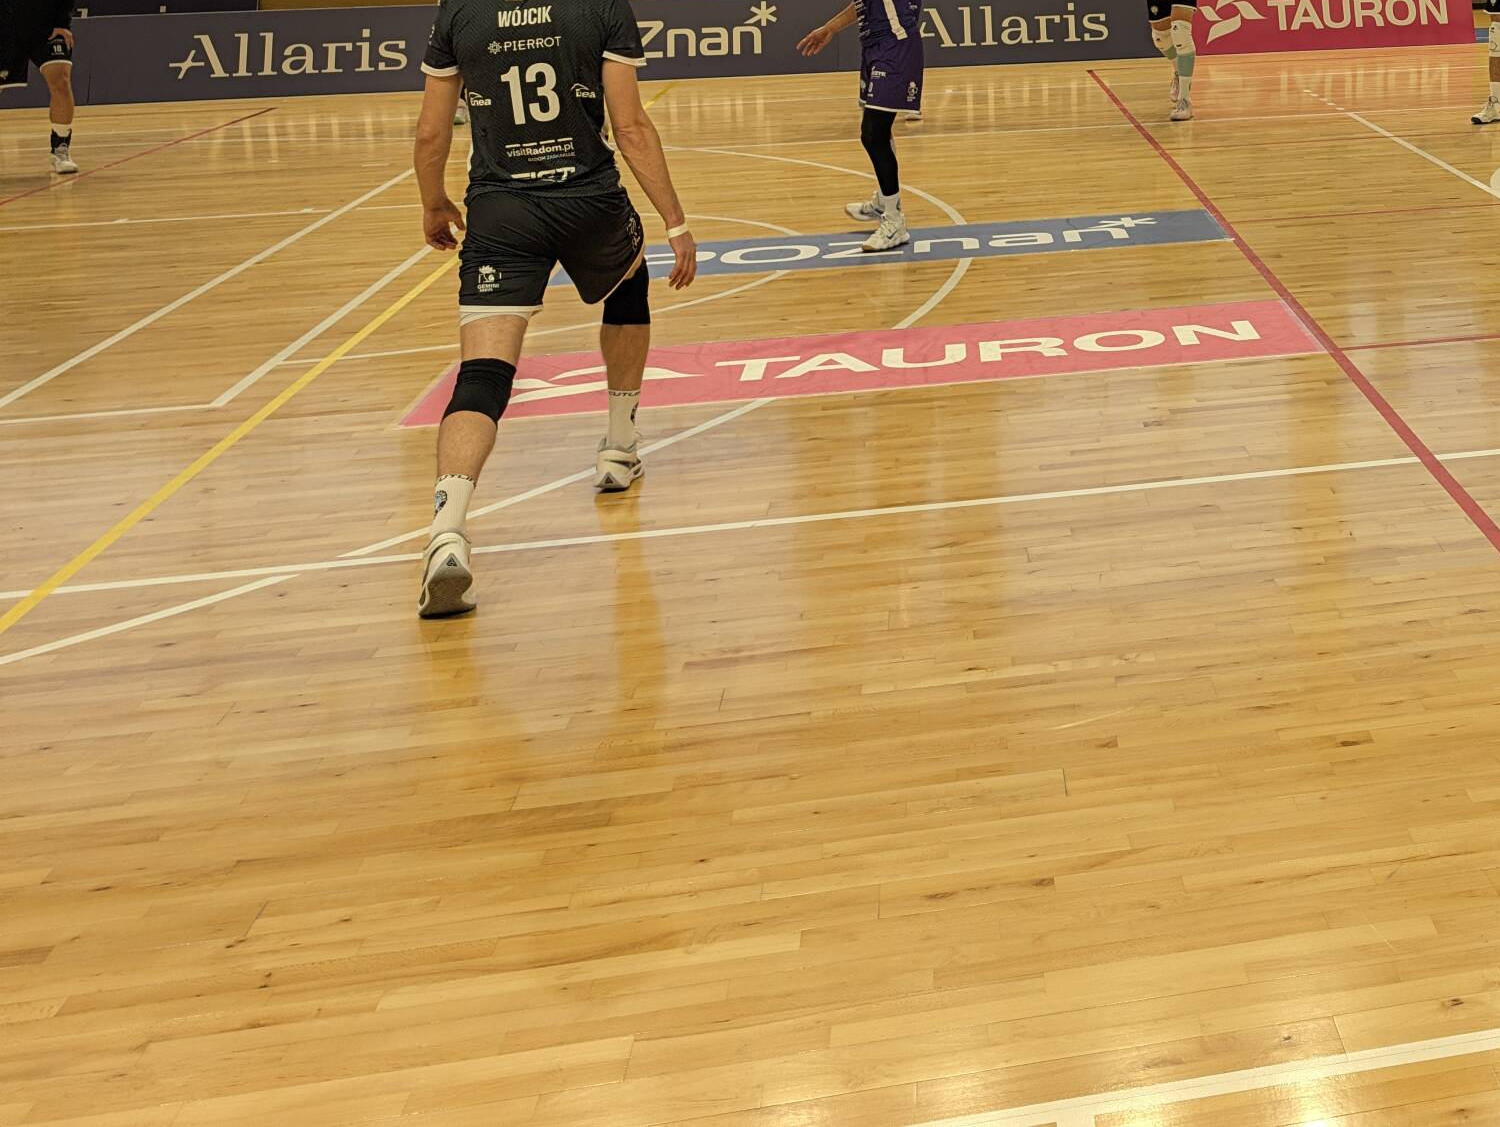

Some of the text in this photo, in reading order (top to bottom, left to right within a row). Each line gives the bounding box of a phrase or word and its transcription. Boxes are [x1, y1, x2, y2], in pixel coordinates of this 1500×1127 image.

[497, 5, 552, 28] WÓJCIK
[919, 2, 1109, 48] Allaris
[168, 28, 408, 80] Allaris
[503, 36, 562, 52] PIERROT
[500, 62, 561, 125] 13
[506, 140, 575, 158] visitRadom.pl
[715, 318, 1262, 383] TAURON
